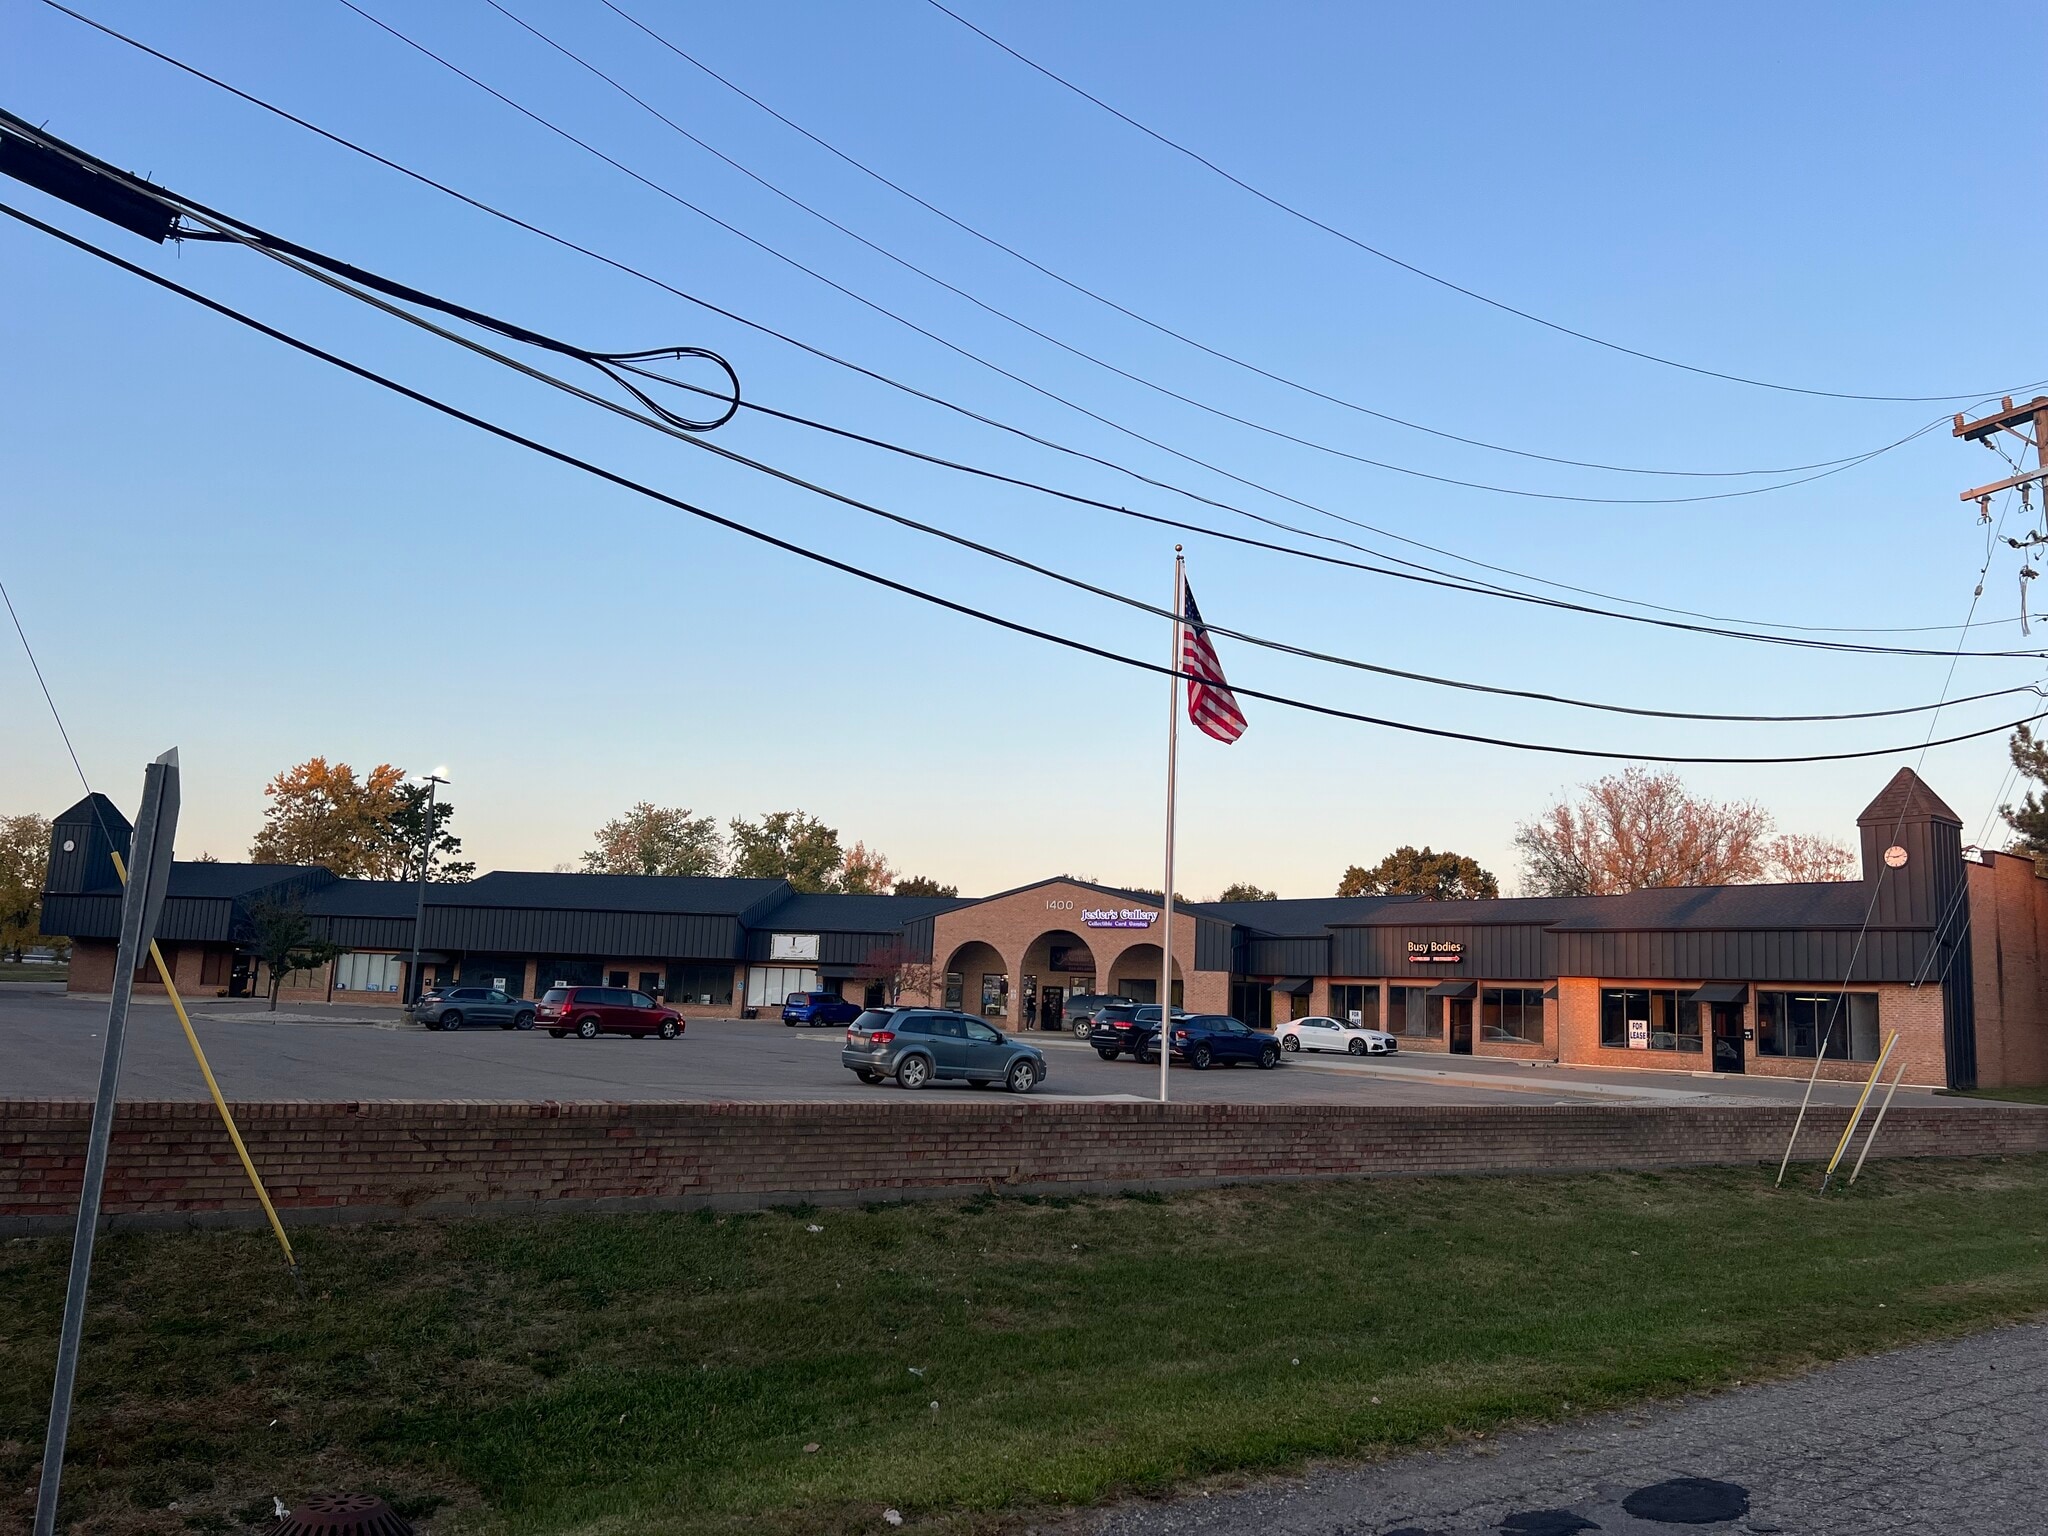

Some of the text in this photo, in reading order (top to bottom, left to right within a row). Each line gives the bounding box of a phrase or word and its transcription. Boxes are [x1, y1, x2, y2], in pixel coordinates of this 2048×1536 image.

[1046, 900, 1074, 910] 1400
[1081, 909, 1158, 922] Jester's Gallery
[1408, 941, 1461, 954] Busy Bodies
[1633, 1022, 1642, 1030] FOR
[1630, 1031, 1646, 1040] LEASE
